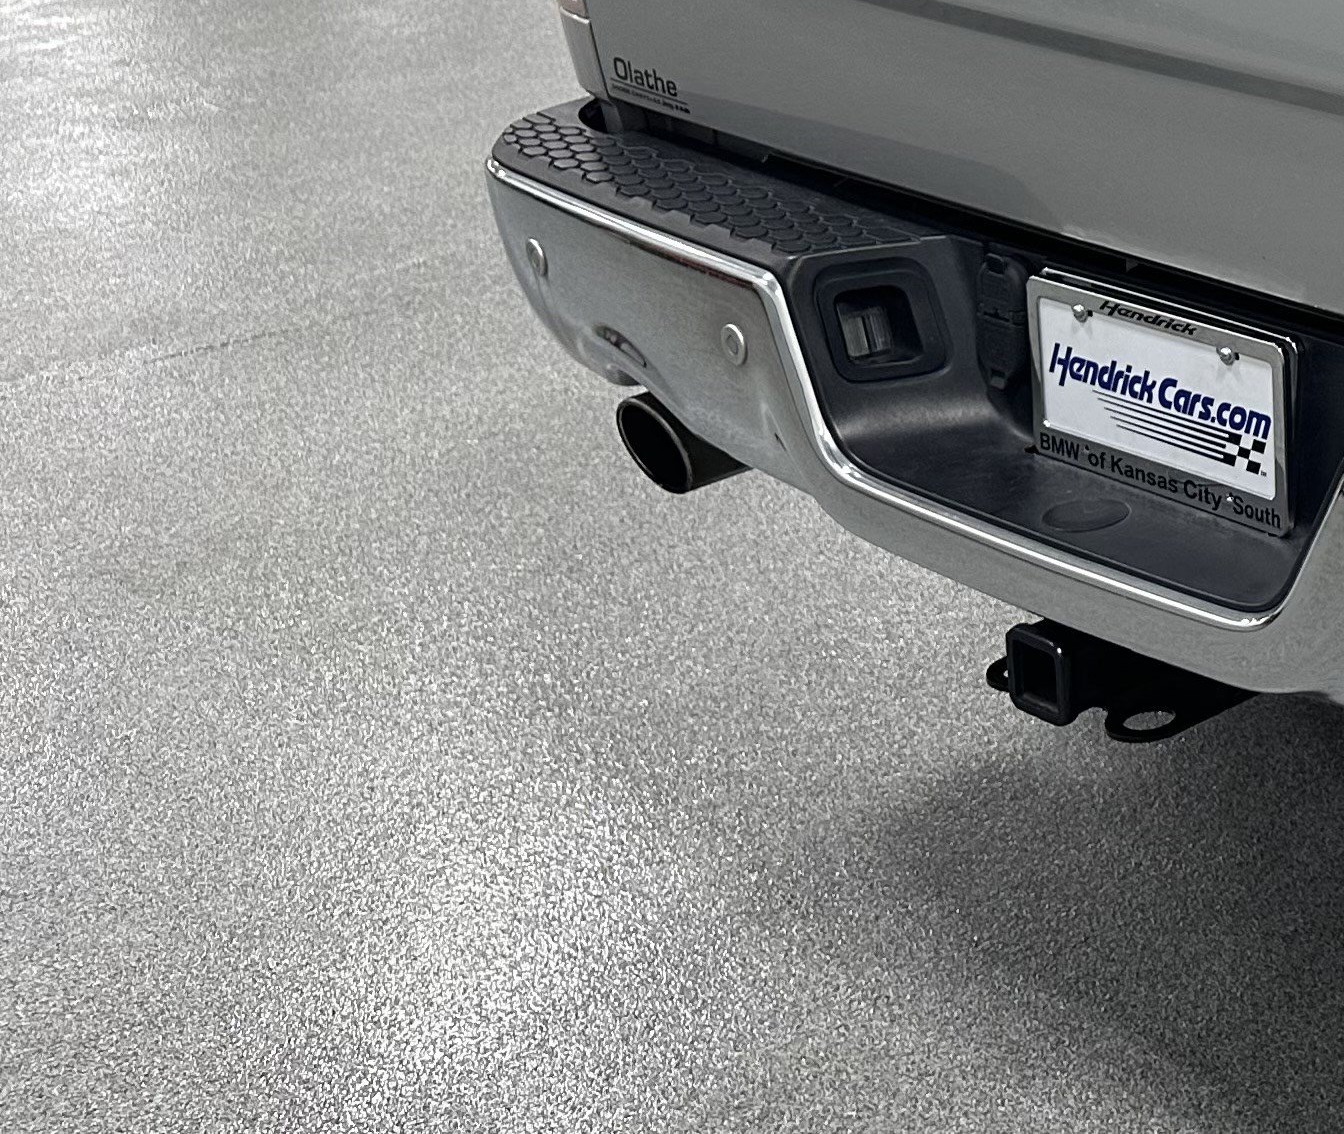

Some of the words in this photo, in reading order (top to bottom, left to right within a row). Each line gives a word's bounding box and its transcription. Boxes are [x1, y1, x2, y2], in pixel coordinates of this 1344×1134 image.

[613, 57, 678, 97] Olathe
[1099, 300, 1197, 336] Hendrick
[1040, 433, 1081, 460] BMW
[1087, 452, 1106, 469] of
[1110, 456, 1178, 493] Kansas
[1183, 479, 1222, 511] City
[1232, 495, 1281, 529] South
